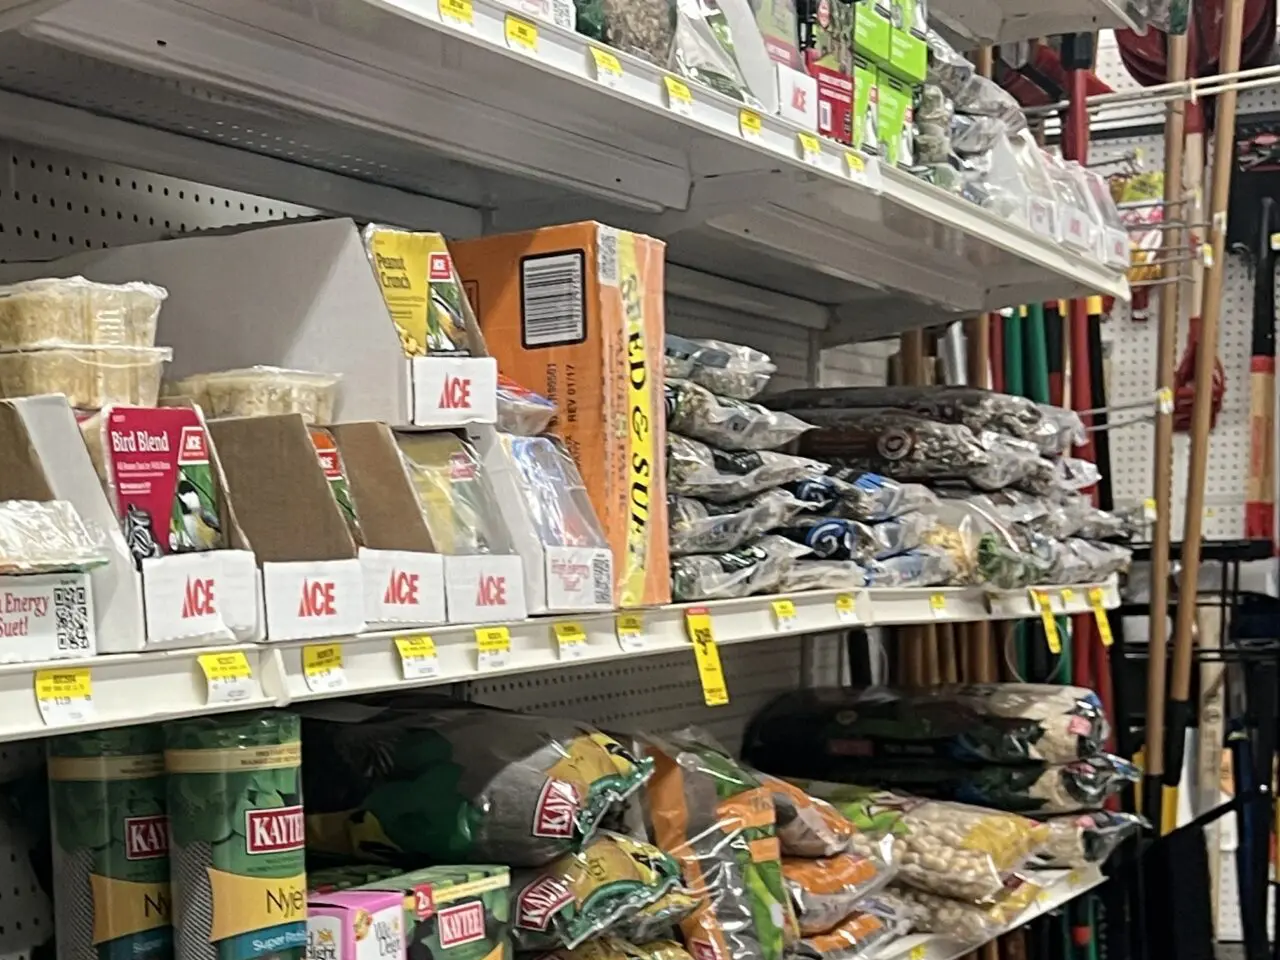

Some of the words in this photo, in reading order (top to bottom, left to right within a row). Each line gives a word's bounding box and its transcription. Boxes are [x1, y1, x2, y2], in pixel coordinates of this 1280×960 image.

[438, 372, 473, 409] ACE
[111, 431, 135, 453] Bird
[137, 431, 169, 452] Blend
[182, 574, 216, 619] ACE
[298, 577, 336, 617] ACE
[384, 568, 419, 604] ACE
[475, 574, 507, 607] ACE
[4, 592, 50, 618] Energy
[252, 932, 284, 952] Super
[442, 910, 481, 943] KAYTEE
